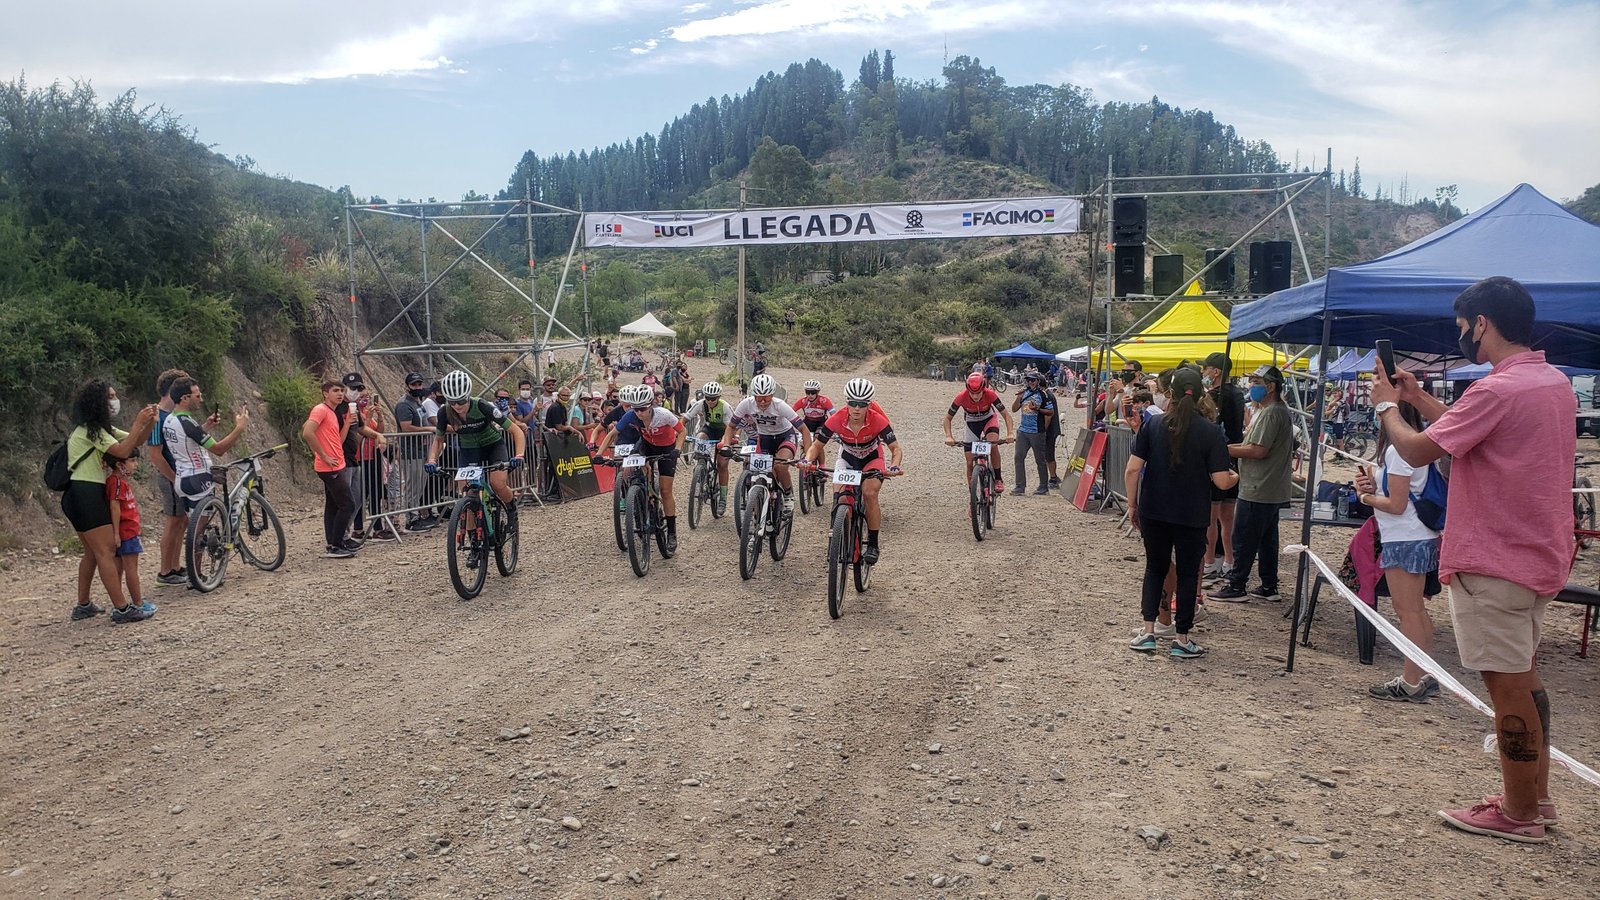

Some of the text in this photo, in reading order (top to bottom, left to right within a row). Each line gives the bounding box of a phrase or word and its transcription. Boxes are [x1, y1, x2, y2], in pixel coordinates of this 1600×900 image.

[972, 208, 1044, 226] FACIMO
[595, 223, 613, 233] FIS
[661, 224, 694, 238] UCI
[724, 212, 877, 240] LLEGADA
[974, 444, 987, 452] 753
[753, 459, 768, 469] 601
[460, 469, 476, 478] 612
[838, 473, 856, 483] 602
